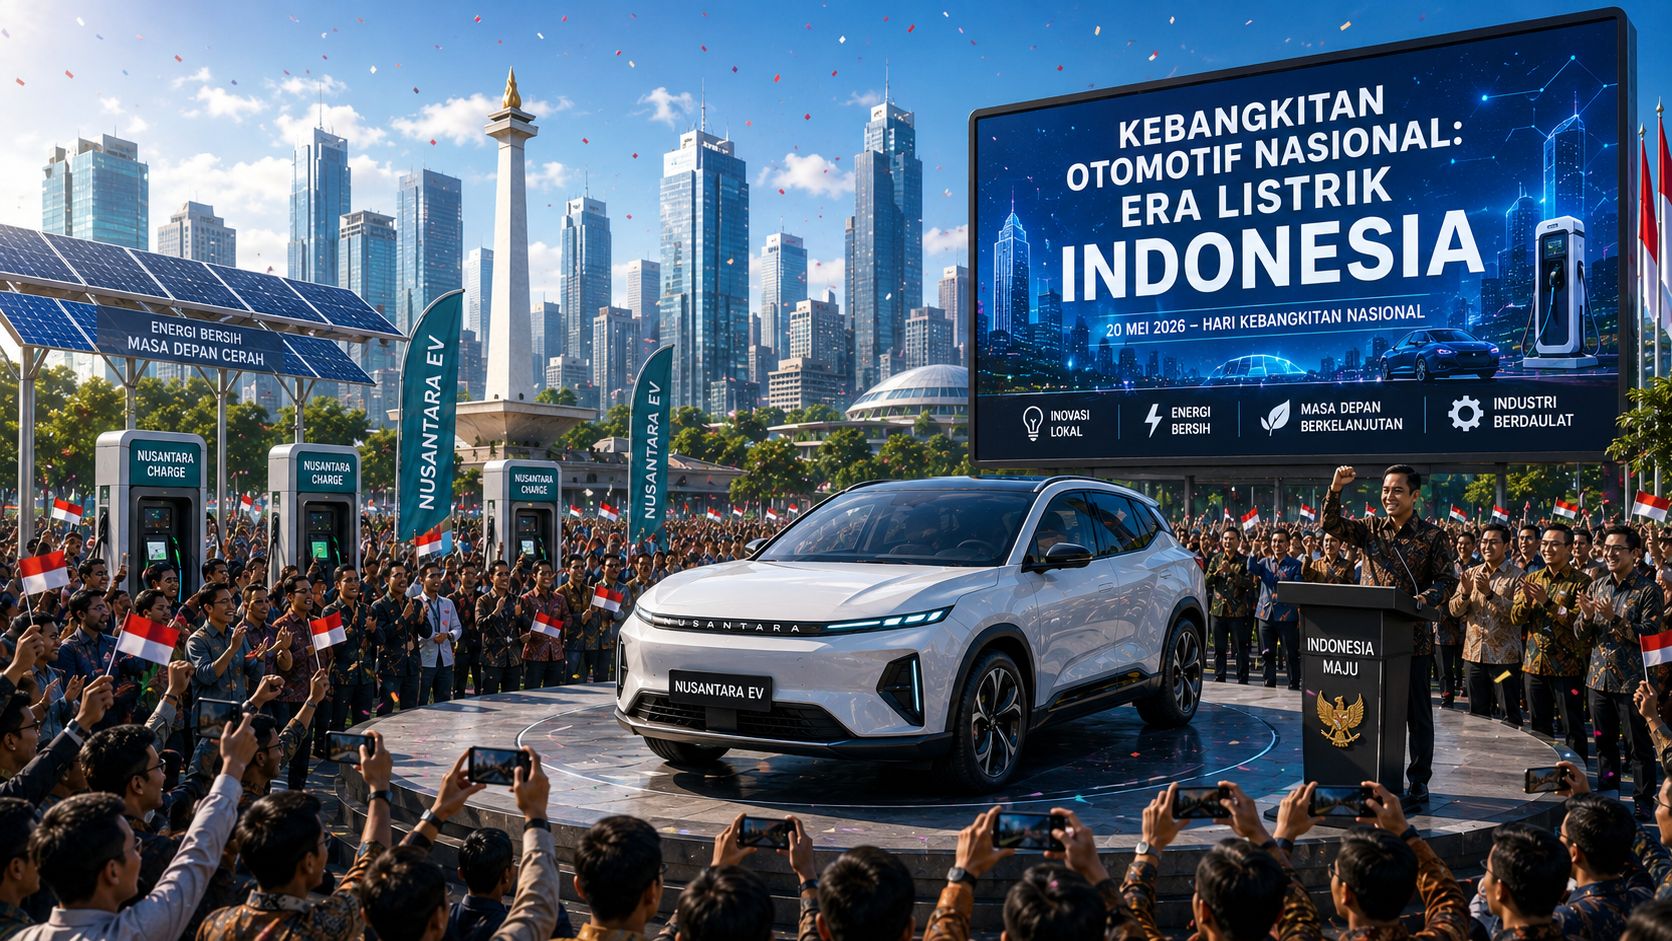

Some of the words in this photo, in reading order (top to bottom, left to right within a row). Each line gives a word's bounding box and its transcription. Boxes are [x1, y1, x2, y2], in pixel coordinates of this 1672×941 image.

[1119, 85, 1385, 149] KEBANGKITAN
[1066, 144, 1244, 191] OTOMOTIF
[1254, 117, 1463, 170] NASIONAL:
[1120, 185, 1201, 228] ERA
[1217, 166, 1392, 218] LISTRIK
[1061, 209, 1485, 303] INDONESIA
[1106, 323, 1122, 338] 20
[1126, 321, 1149, 336] MEI
[1153, 319, 1186, 335] 2026
[1203, 315, 1236, 332] HARI
[1240, 308, 1342, 330] KEBANGKITAN
[1347, 303, 1426, 323] NASIONAL
[151, 320, 196, 339] ENERGI
[200, 327, 242, 345] BERSIH
[127, 335, 170, 354] MASA
[173, 341, 218, 360] DEPAN
[222, 348, 264, 366] CERAH
[426, 334, 445, 367] EV
[648, 380, 661, 406] EV
[1301, 402, 1336, 415] MASA
[1340, 400, 1381, 414] DEPAN
[1493, 395, 1557, 410] INDUSTRI
[1050, 409, 1090, 422] INOVASI
[1171, 405, 1211, 419] ENERGI
[1171, 422, 1211, 435] BERSIH
[1300, 417, 1403, 432] BERKELANJUTAN
[1493, 413, 1575, 428] BERDAULAT
[1050, 425, 1083, 438] LOKAL
[418, 375, 442, 510] NUSANTARA
[137, 449, 194, 464] NUSANTARA
[147, 465, 186, 478] CHARGE
[303, 460, 351, 473] NUSANTARA
[644, 412, 659, 519] NUSANTARA
[311, 474, 343, 486] CHARGE
[514, 473, 554, 484] NUSANTARA
[664, 618, 800, 633] NUSANTARA
[1307, 637, 1375, 656] INDONESIA
[1323, 659, 1358, 676] MAJU
[675, 680, 745, 698] NUSANTARA
[748, 686, 764, 700] EV
